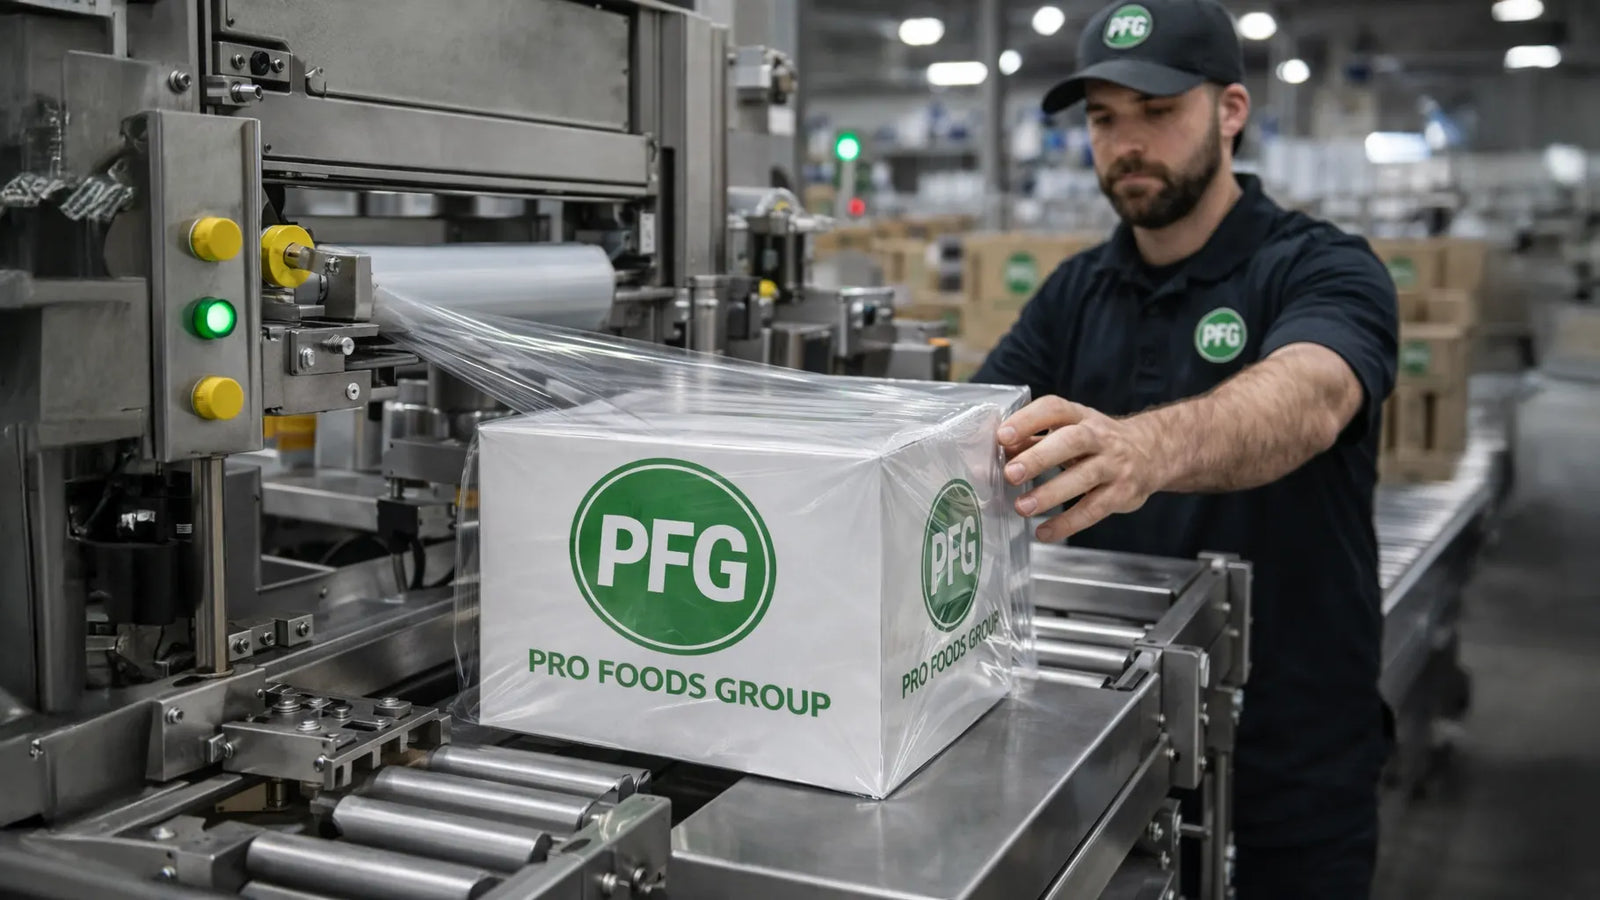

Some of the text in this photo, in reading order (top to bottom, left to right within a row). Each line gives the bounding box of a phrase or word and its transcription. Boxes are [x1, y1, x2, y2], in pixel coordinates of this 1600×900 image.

[1107, 16, 1148, 38] PFG
[1202, 322, 1240, 348] PFG
[597, 514, 748, 603] PFG
[931, 515, 976, 597] PFG
[529, 648, 832, 718] PRO FOODS GROUP
[902, 609, 999, 699] PRO FOODS GROUP
